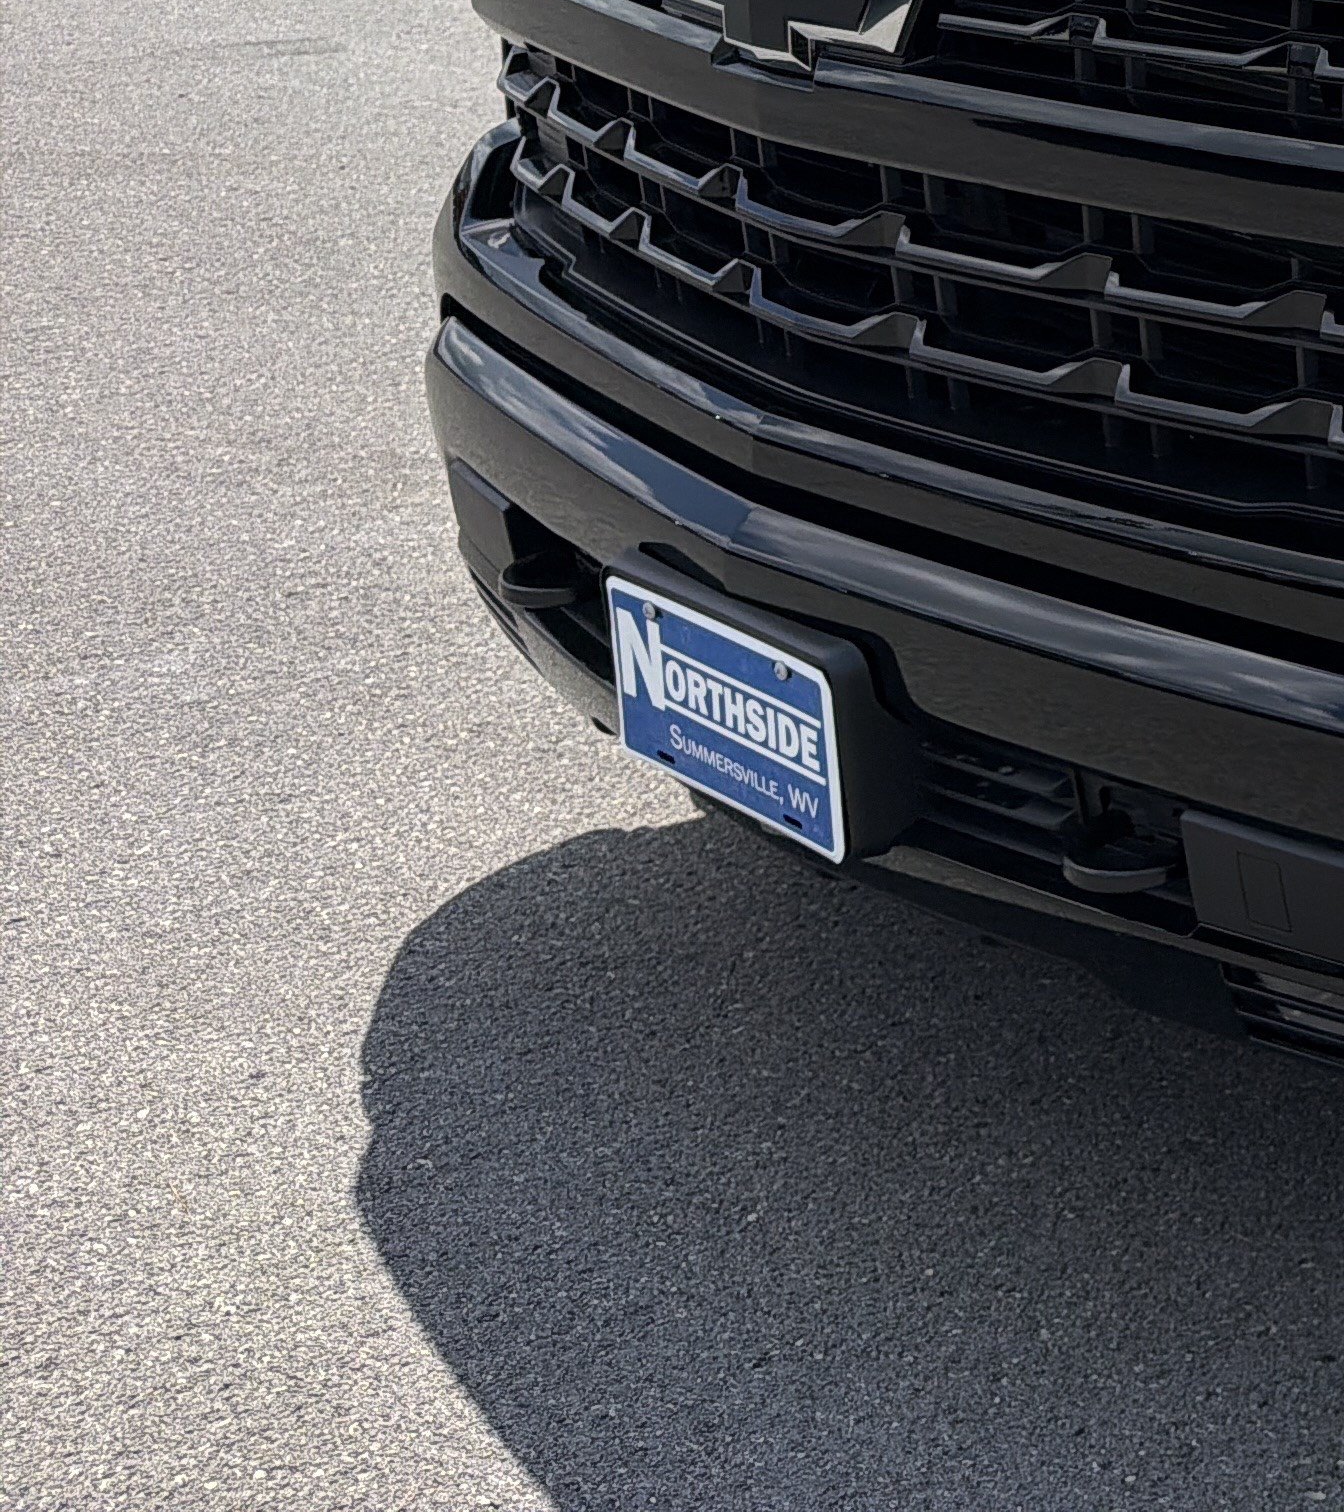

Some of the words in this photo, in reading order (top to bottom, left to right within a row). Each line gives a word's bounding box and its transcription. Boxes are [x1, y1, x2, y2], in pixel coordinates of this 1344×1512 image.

[615, 606, 822, 774] NORTHSIDE
[669, 724, 785, 806] SUMMERSVILLE,
[787, 784, 819, 819] WV
